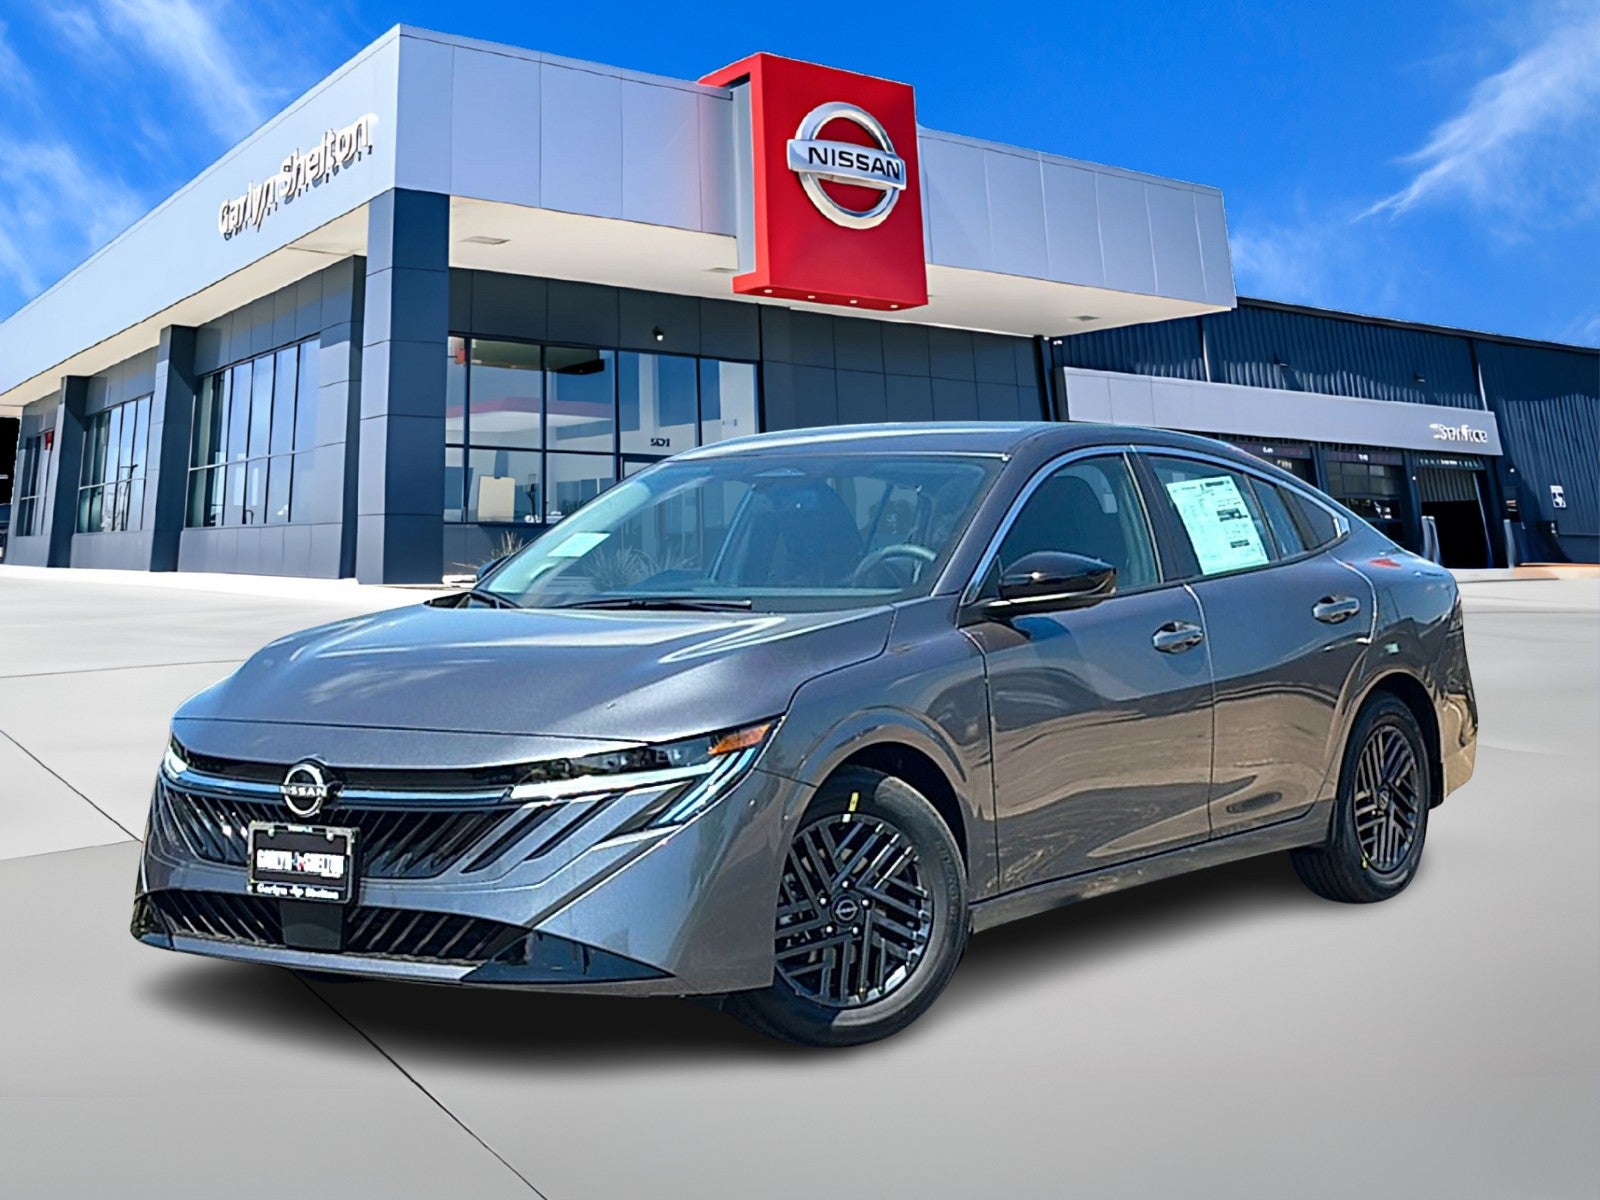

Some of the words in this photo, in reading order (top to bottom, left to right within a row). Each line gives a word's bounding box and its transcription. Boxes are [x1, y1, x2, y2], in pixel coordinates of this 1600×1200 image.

[277, 115, 374, 204] Shelton
[808, 146, 900, 180] NISSAN
[280, 784, 327, 797] NISSAN
